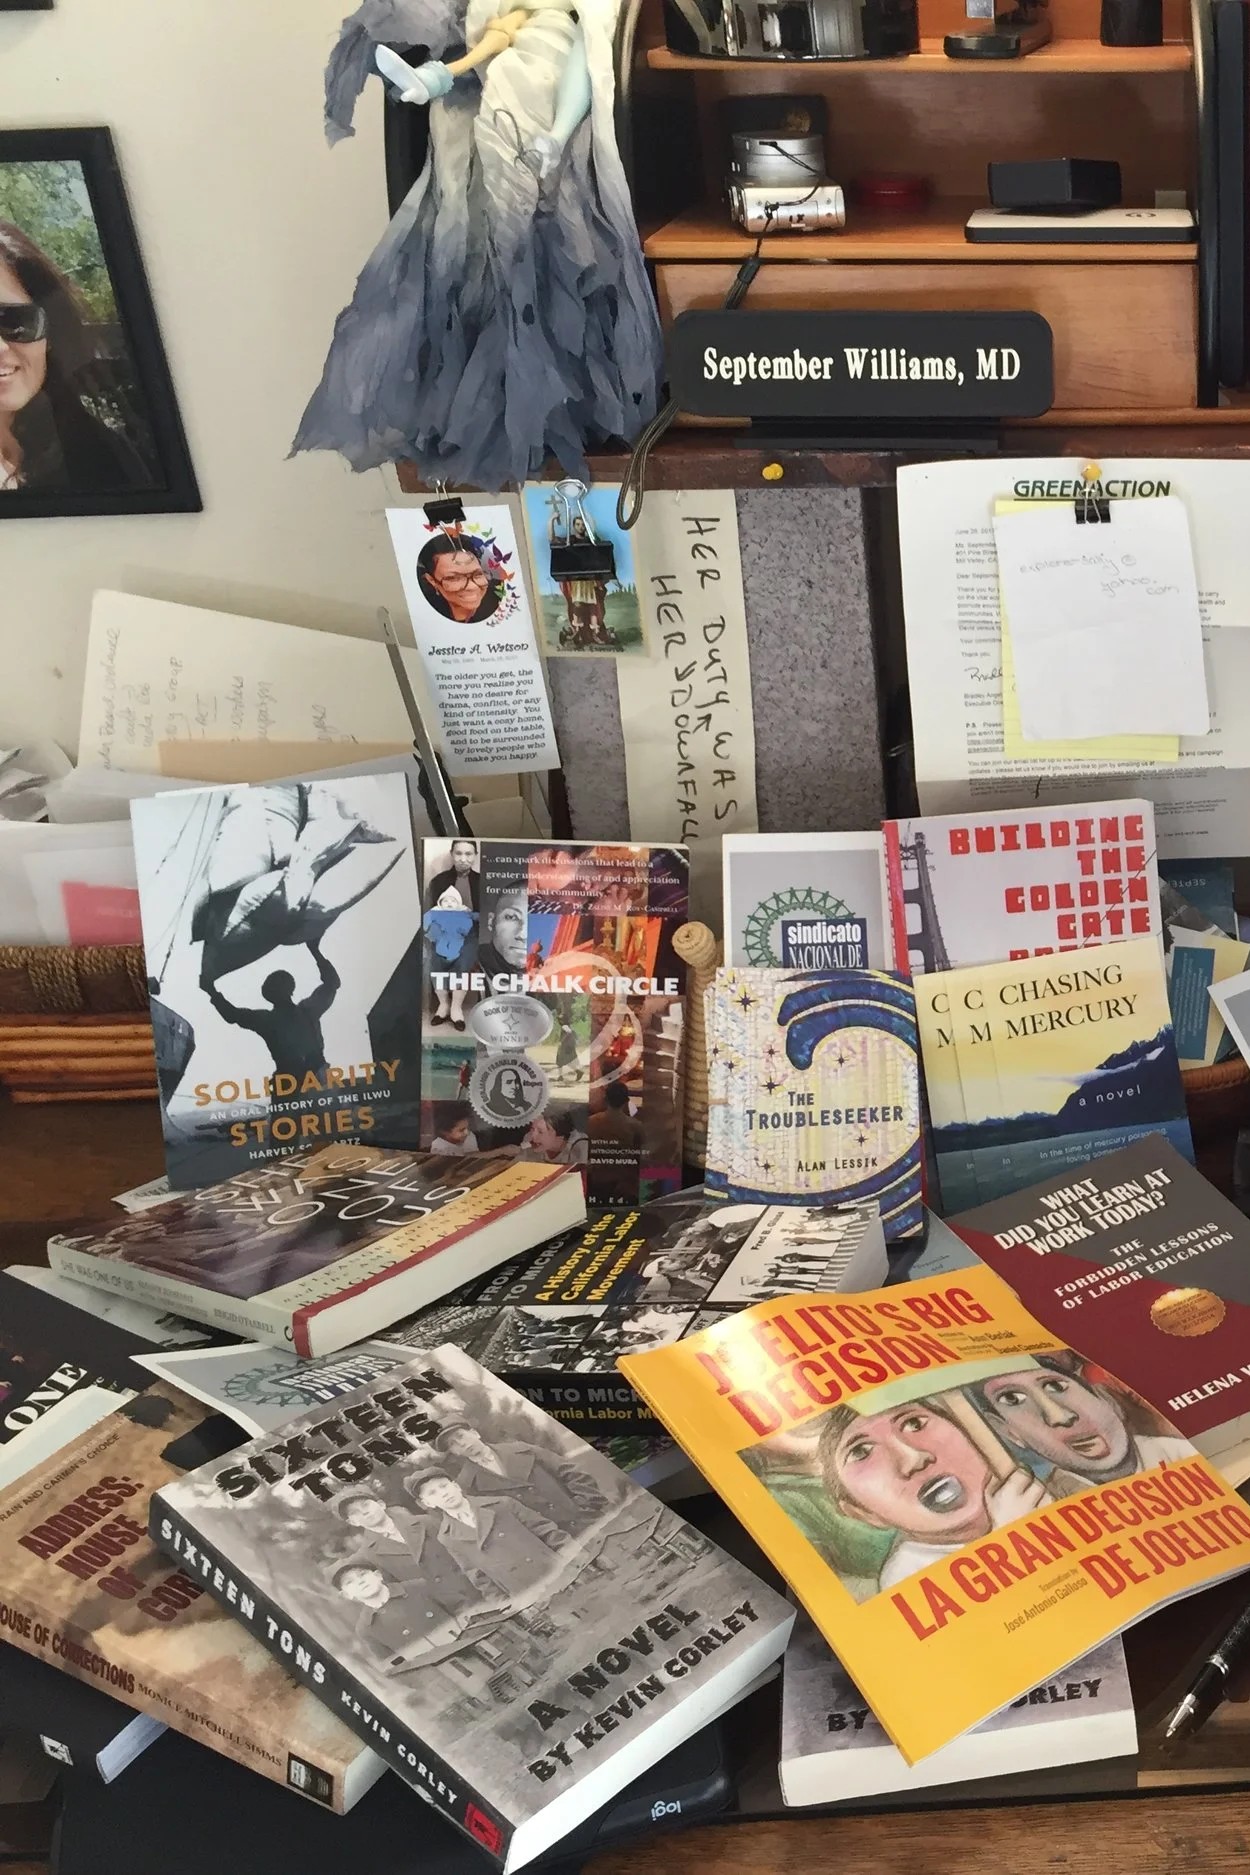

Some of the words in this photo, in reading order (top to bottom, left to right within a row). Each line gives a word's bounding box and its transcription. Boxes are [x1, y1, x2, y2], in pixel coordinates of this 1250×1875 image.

[703, 346, 833, 385] September
[843, 348, 964, 386] Williams,
[976, 348, 1020, 380] MD
[1014, 480, 1171, 498] GREENACTION
[682, 517, 720, 590] HER
[650, 574, 686, 659] HER
[428, 645, 466, 656] Jessica
[486, 643, 529, 653] Watson
[435, 673, 452, 681] The
[454, 672, 479, 680] older
[480, 673, 497, 681] you
[483, 680, 514, 688] realize
[516, 678, 534, 686] you
[949, 815, 1144, 855] BUILDING
[486, 871, 520, 882] greater
[521, 871, 590, 884] understanding
[591, 873, 602, 882] of
[602, 873, 621, 883] and
[622, 874, 680, 887] appreciation
[1077, 846, 1146, 875] THE
[486, 885, 500, 895] for
[501, 887, 521, 895] our
[523, 887, 550, 898] global
[1005, 876, 1148, 913] GOLDEN
[787, 921, 862, 946] sindicato
[1057, 907, 1150, 939] GATE
[788, 943, 847, 969] NACIONAL
[847, 943, 863, 968] DE
[430, 972, 485, 991] THE
[489, 972, 586, 994] CHALK
[589, 975, 679, 995] CIRCLE
[999, 964, 1123, 1005] CHASING
[1005, 994, 1137, 1040] MERCURY
[193, 1059, 401, 1107] SOLIDARITY
[788, 1091, 814, 1107] THE
[1079, 1096, 1086, 1106] a
[1096, 1084, 1141, 1103] novel
[209, 1111, 227, 1121] AN
[230, 1106, 262, 1118] ORAL
[265, 1098, 315, 1114] HISTORY
[317, 1096, 332, 1107] OF
[336, 1093, 360, 1104] THE
[362, 1089, 391, 1102] ILWU
[230, 1105, 375, 1147] STORIES
[746, 1104, 904, 1130] TROUBLESEEKER
[249, 1146, 295, 1160] HARVEY
[797, 1159, 826, 1173] ALAN
[834, 1156, 878, 1171] LESSIK
[1049, 1148, 1063, 1158] the
[1064, 1144, 1083, 1155] time
[1083, 1141, 1092, 1151] of
[1093, 1136, 1127, 1151] mercury
[194, 1155, 313, 1205] SHE
[216, 1157, 373, 1215] WAS
[266, 1159, 418, 1226] ONE
[337, 1177, 421, 1221] OF
[1039, 1178, 1101, 1211] WHAT
[375, 1184, 473, 1227] US
[993, 1224, 1037, 1250] DID
[1033, 1205, 1081, 1233] YOU
[1079, 1180, 1146, 1216] LEARN
[1143, 1168, 1174, 1190] AT
[1025, 1220, 1096, 1257] WORK
[1088, 1191, 1167, 1231] TODAY?
[534, 1286, 551, 1302] A
[545, 1244, 592, 1291] History
[584, 1230, 601, 1247] of
[596, 1212, 617, 1236] the
[560, 1237, 621, 1301] California
[613, 1209, 642, 1241] Labor
[586, 1237, 646, 1302] Movement
[1053, 1252, 1149, 1298] FORBIDDEN
[1149, 1221, 1220, 1258] LESSONS
[1109, 1238, 1145, 1258] THE
[476, 1261, 522, 1302] FROM
[1061, 1295, 1085, 1310] OF
[1087, 1270, 1145, 1299] LABOR
[1145, 1231, 1235, 1275] EDUCATION
[503, 1283, 528, 1303] TO
[695, 1302, 922, 1396] JELITO'S
[902, 1287, 995, 1329] BIG
[4, 1362, 88, 1431] ONE
[727, 1333, 963, 1437] DECISION
[1167, 1372, 1243, 1412] HELENA
[214, 1365, 456, 1502] SIXTEEN
[22, 1489, 44, 1506] AND
[43, 1457, 88, 1491] CARMIN'S
[87, 1432, 120, 1460] CHOICE
[287, 1411, 444, 1503] TONS
[18, 1476, 145, 1560] ADDRESS:
[54, 1513, 149, 1581] HOUSE
[890, 1577, 967, 1640] LA
[949, 1514, 1077, 1603] GRAN
[1057, 1460, 1225, 1544] DECISIÓN
[96, 1565, 147, 1601] OF
[1079, 1543, 1151, 1599] DE
[161, 1518, 256, 1621] SIXTEEN
[265, 1616, 326, 1684] TONS
[1003, 1613, 1026, 1634] José
[1023, 1595, 1058, 1621] Antonio
[1055, 1577, 1088, 1600] Galloso
[33, 1623, 50, 1647] OF
[51, 1632, 135, 1694] CORRECTIONS
[527, 1699, 572, 1732] A
[566, 1603, 702, 1700] NOVEL
[526, 1740, 574, 1783] BY
[573, 1673, 667, 1750] KEVIN
[662, 1600, 760, 1678] CORLEY
[138, 1682, 182, 1713] MONICE
[181, 1708, 242, 1746] MITCHELL
[243, 1740, 283, 1767] SIMMS
[825, 1708, 870, 1733] BY
[341, 1690, 391, 1743] KEVIN
[397, 1743, 458, 1805] CORLEY
[651, 1800, 681, 1821] logi
